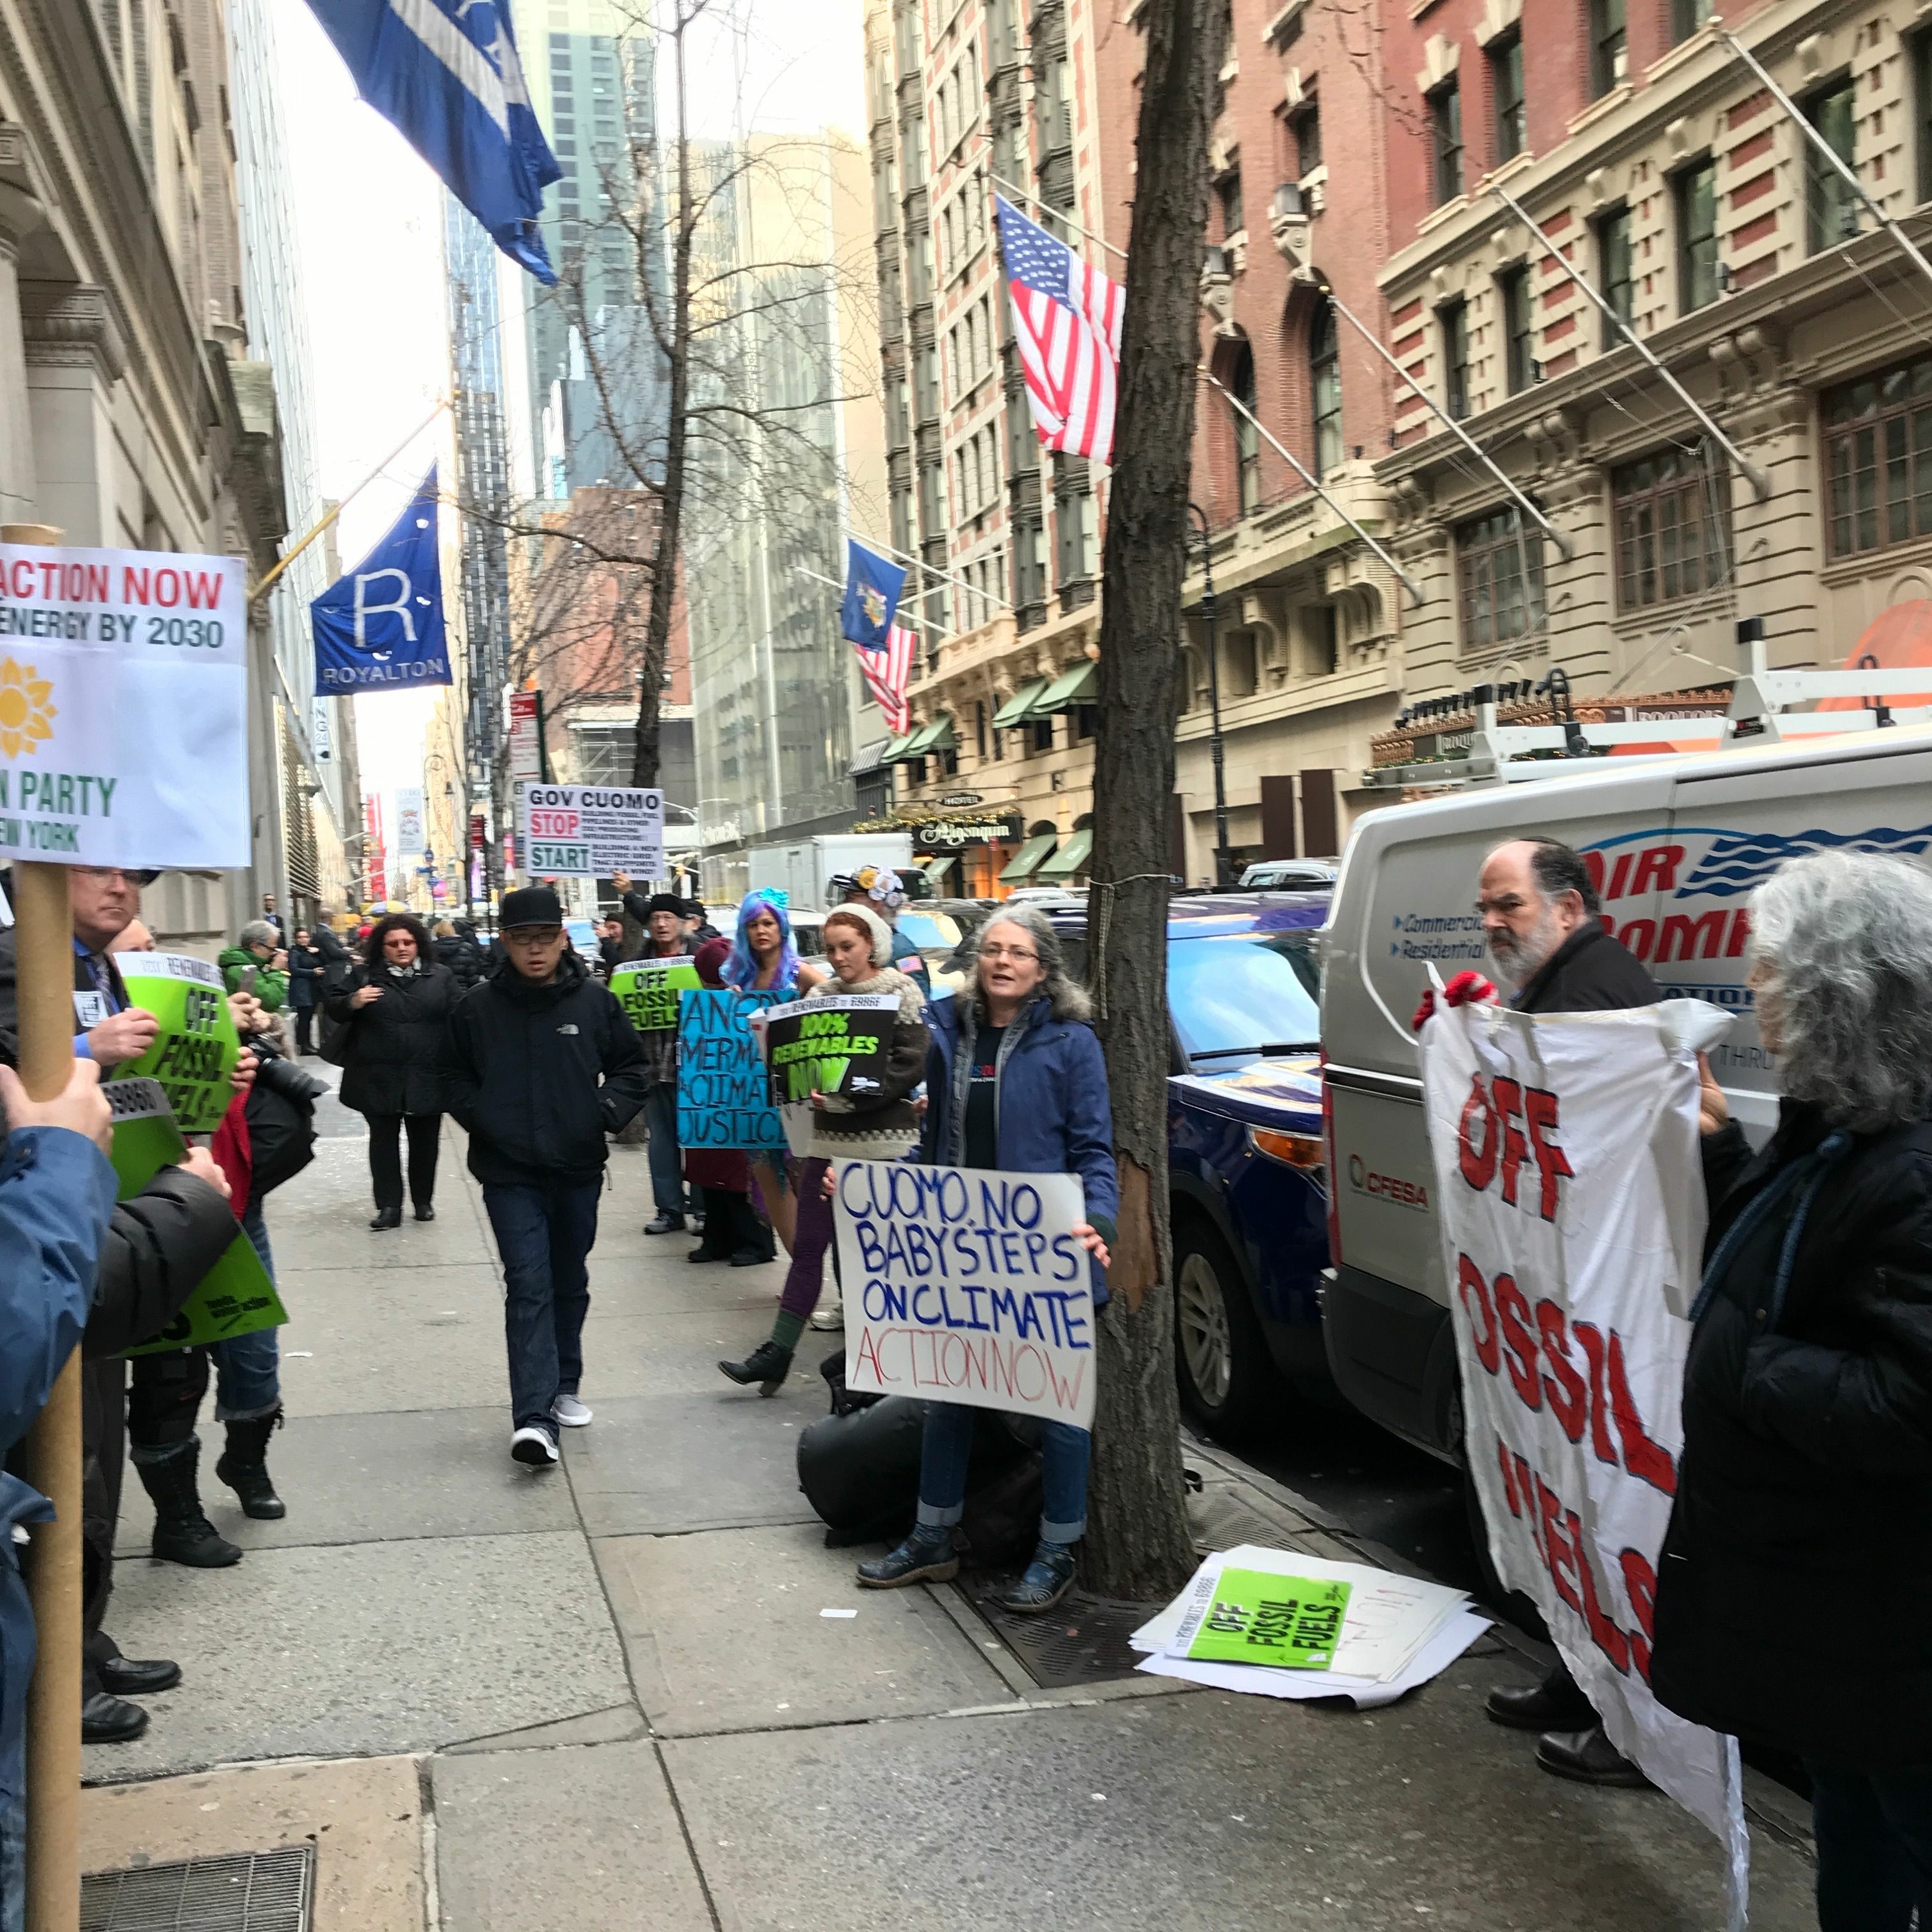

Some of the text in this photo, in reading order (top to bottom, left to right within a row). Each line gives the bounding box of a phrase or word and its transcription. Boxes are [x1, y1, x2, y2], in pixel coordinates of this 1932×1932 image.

[123, 565, 223, 611] NOW
[354, 568, 418, 647] R
[99, 613, 138, 643] BY
[146, 616, 224, 649] 2030
[325, 658, 444, 684] ROYALTON
[19, 771, 117, 817] PARTY
[530, 790, 659, 810] GOV CUOMO
[943, 796, 978, 805] HOTEL
[0, 817, 80, 853] EW YORK
[531, 813, 579, 835] STOP
[531, 846, 589, 868] START
[634, 971, 668, 990] OFF
[628, 1009, 678, 1028] FUEL
[682, 992, 799, 1034] ANG
[798, 1012, 851, 1039] 100%
[681, 1034, 764, 1072] MERM
[772, 1036, 880, 1066] RENEWABLES
[688, 1073, 768, 1108] CLIMA
[788, 1056, 852, 1101] NOW
[1459, 1071, 1575, 1223] OFF
[979, 1179, 1043, 1231] NO
[855, 1220, 1080, 1282] BABY STEPS
[863, 1278, 1092, 1350] ON CLIMATE
[852, 1325, 1086, 1411] ACTION NOW
[1458, 1252, 1676, 1499] OSSIL
[1207, 1602, 1253, 1633] OFF
[1246, 1599, 1299, 1647] FOSSIL
[1291, 1603, 1341, 1651] FUELS
